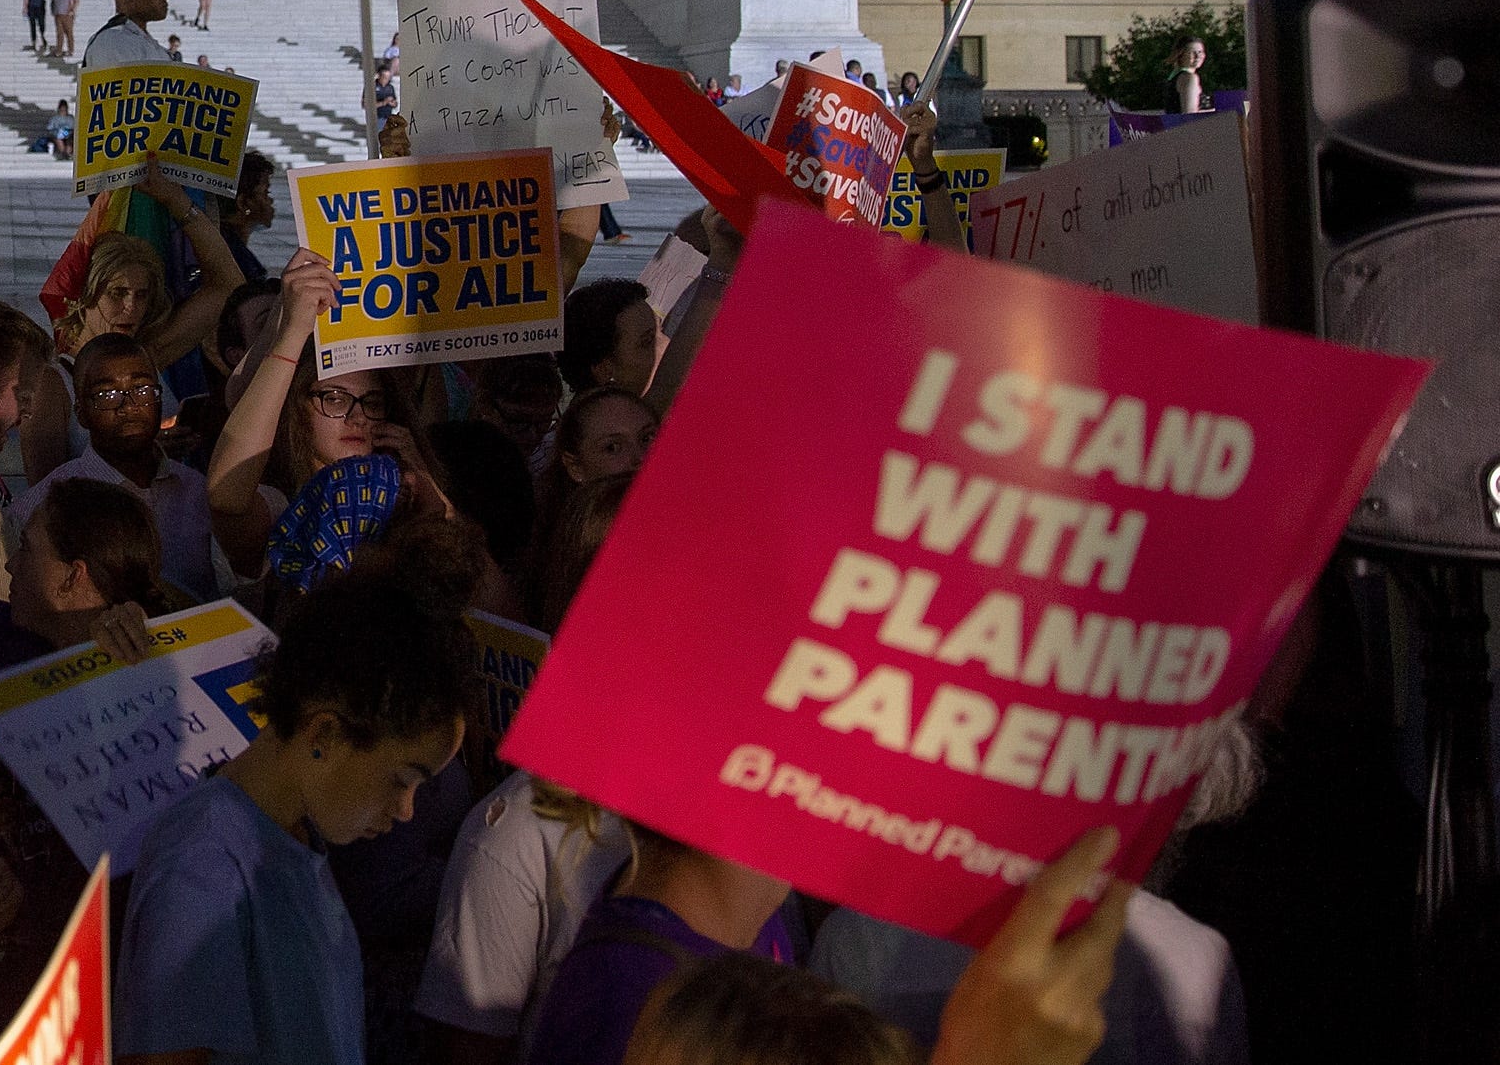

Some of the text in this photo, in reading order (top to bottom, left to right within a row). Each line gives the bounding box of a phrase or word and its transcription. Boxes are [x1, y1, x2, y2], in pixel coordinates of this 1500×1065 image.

[403, 7, 583, 44] TRUMP THOUT
[90, 77, 240, 108] WE DEMAND
[409, 55, 579, 88] THE COURT WAS
[88, 96, 235, 136] A JUSTICE
[409, 97, 578, 135] A PIZZA UNTIL
[86, 126, 230, 166] FOR ALL
[554, 150, 618, 183] YEAR
[107, 174, 126, 183] TEXT
[192, 173, 204, 183] TO
[319, 177, 540, 223] WE DEMAND
[980, 191, 1045, 259] 77%
[1062, 187, 1082, 232] of
[1142, 156, 1214, 208] abortion
[333, 210, 541, 274] A JUSTICE
[330, 260, 548, 324] FOR ALL
[1131, 265, 1170, 294] men
[366, 328, 559, 357] TEXT SAVE SCOTUS TO 30644
[896, 347, 1257, 502] I STAND
[871, 447, 1148, 595] WITH
[808, 546, 1232, 707] PLANNED
[761, 635, 1197, 808] PARENTH
[43, 710, 208, 792] RIGHTS
[766, 763, 943, 856] Planned
